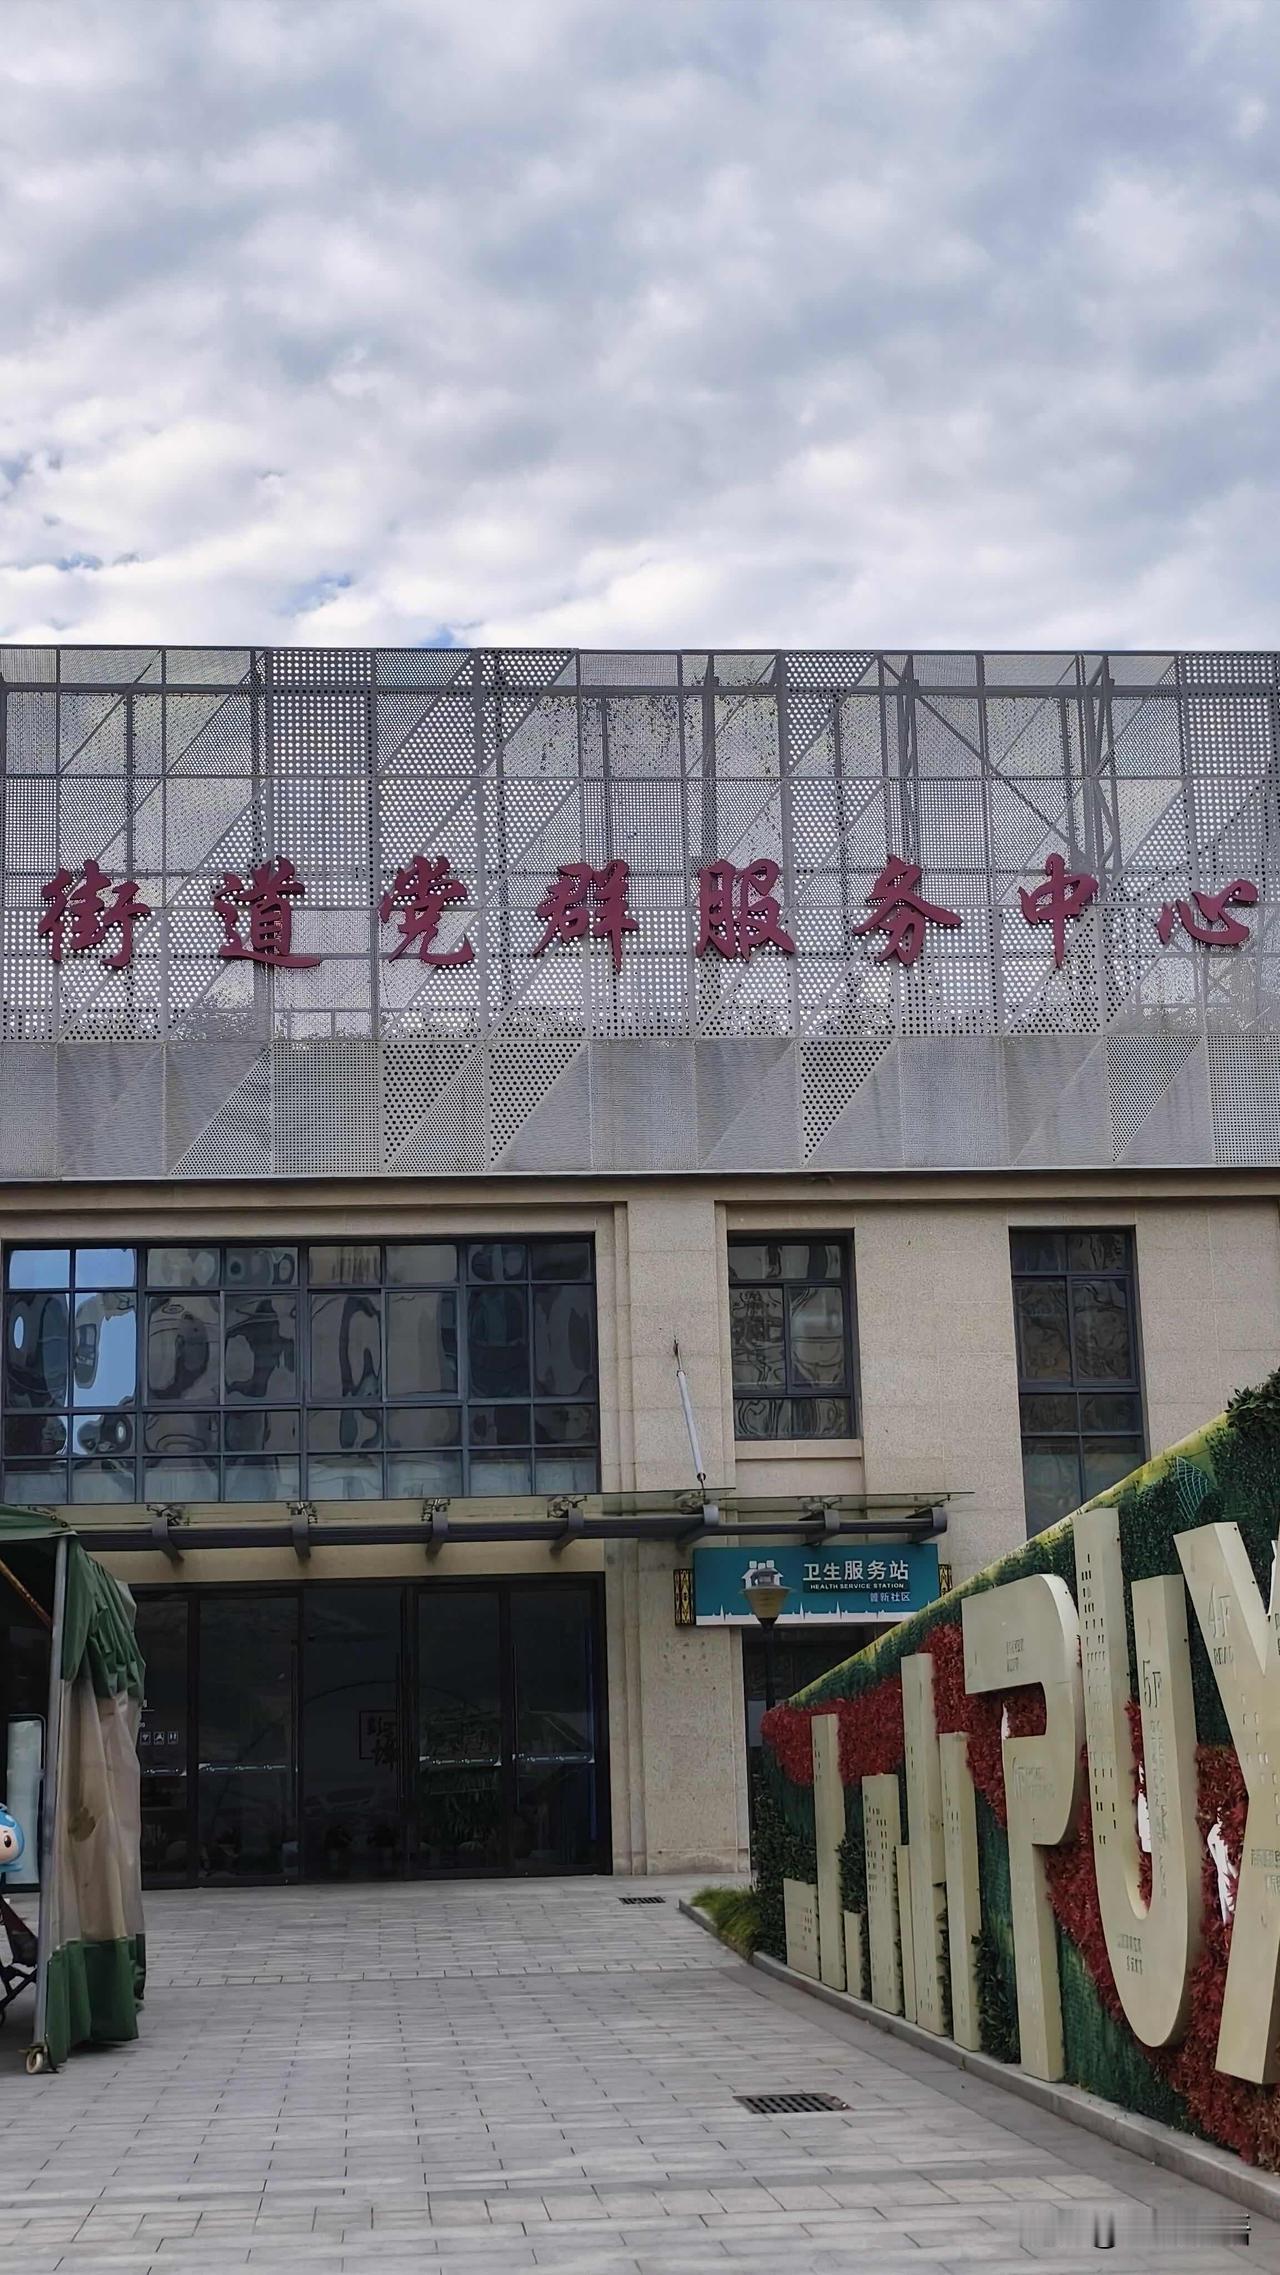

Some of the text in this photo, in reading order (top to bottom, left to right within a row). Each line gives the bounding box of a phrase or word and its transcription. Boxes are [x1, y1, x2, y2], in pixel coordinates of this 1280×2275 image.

[38, 852, 1259, 975] 街道党群服务中心
[803, 1560, 909, 1581] 卫生服务站
